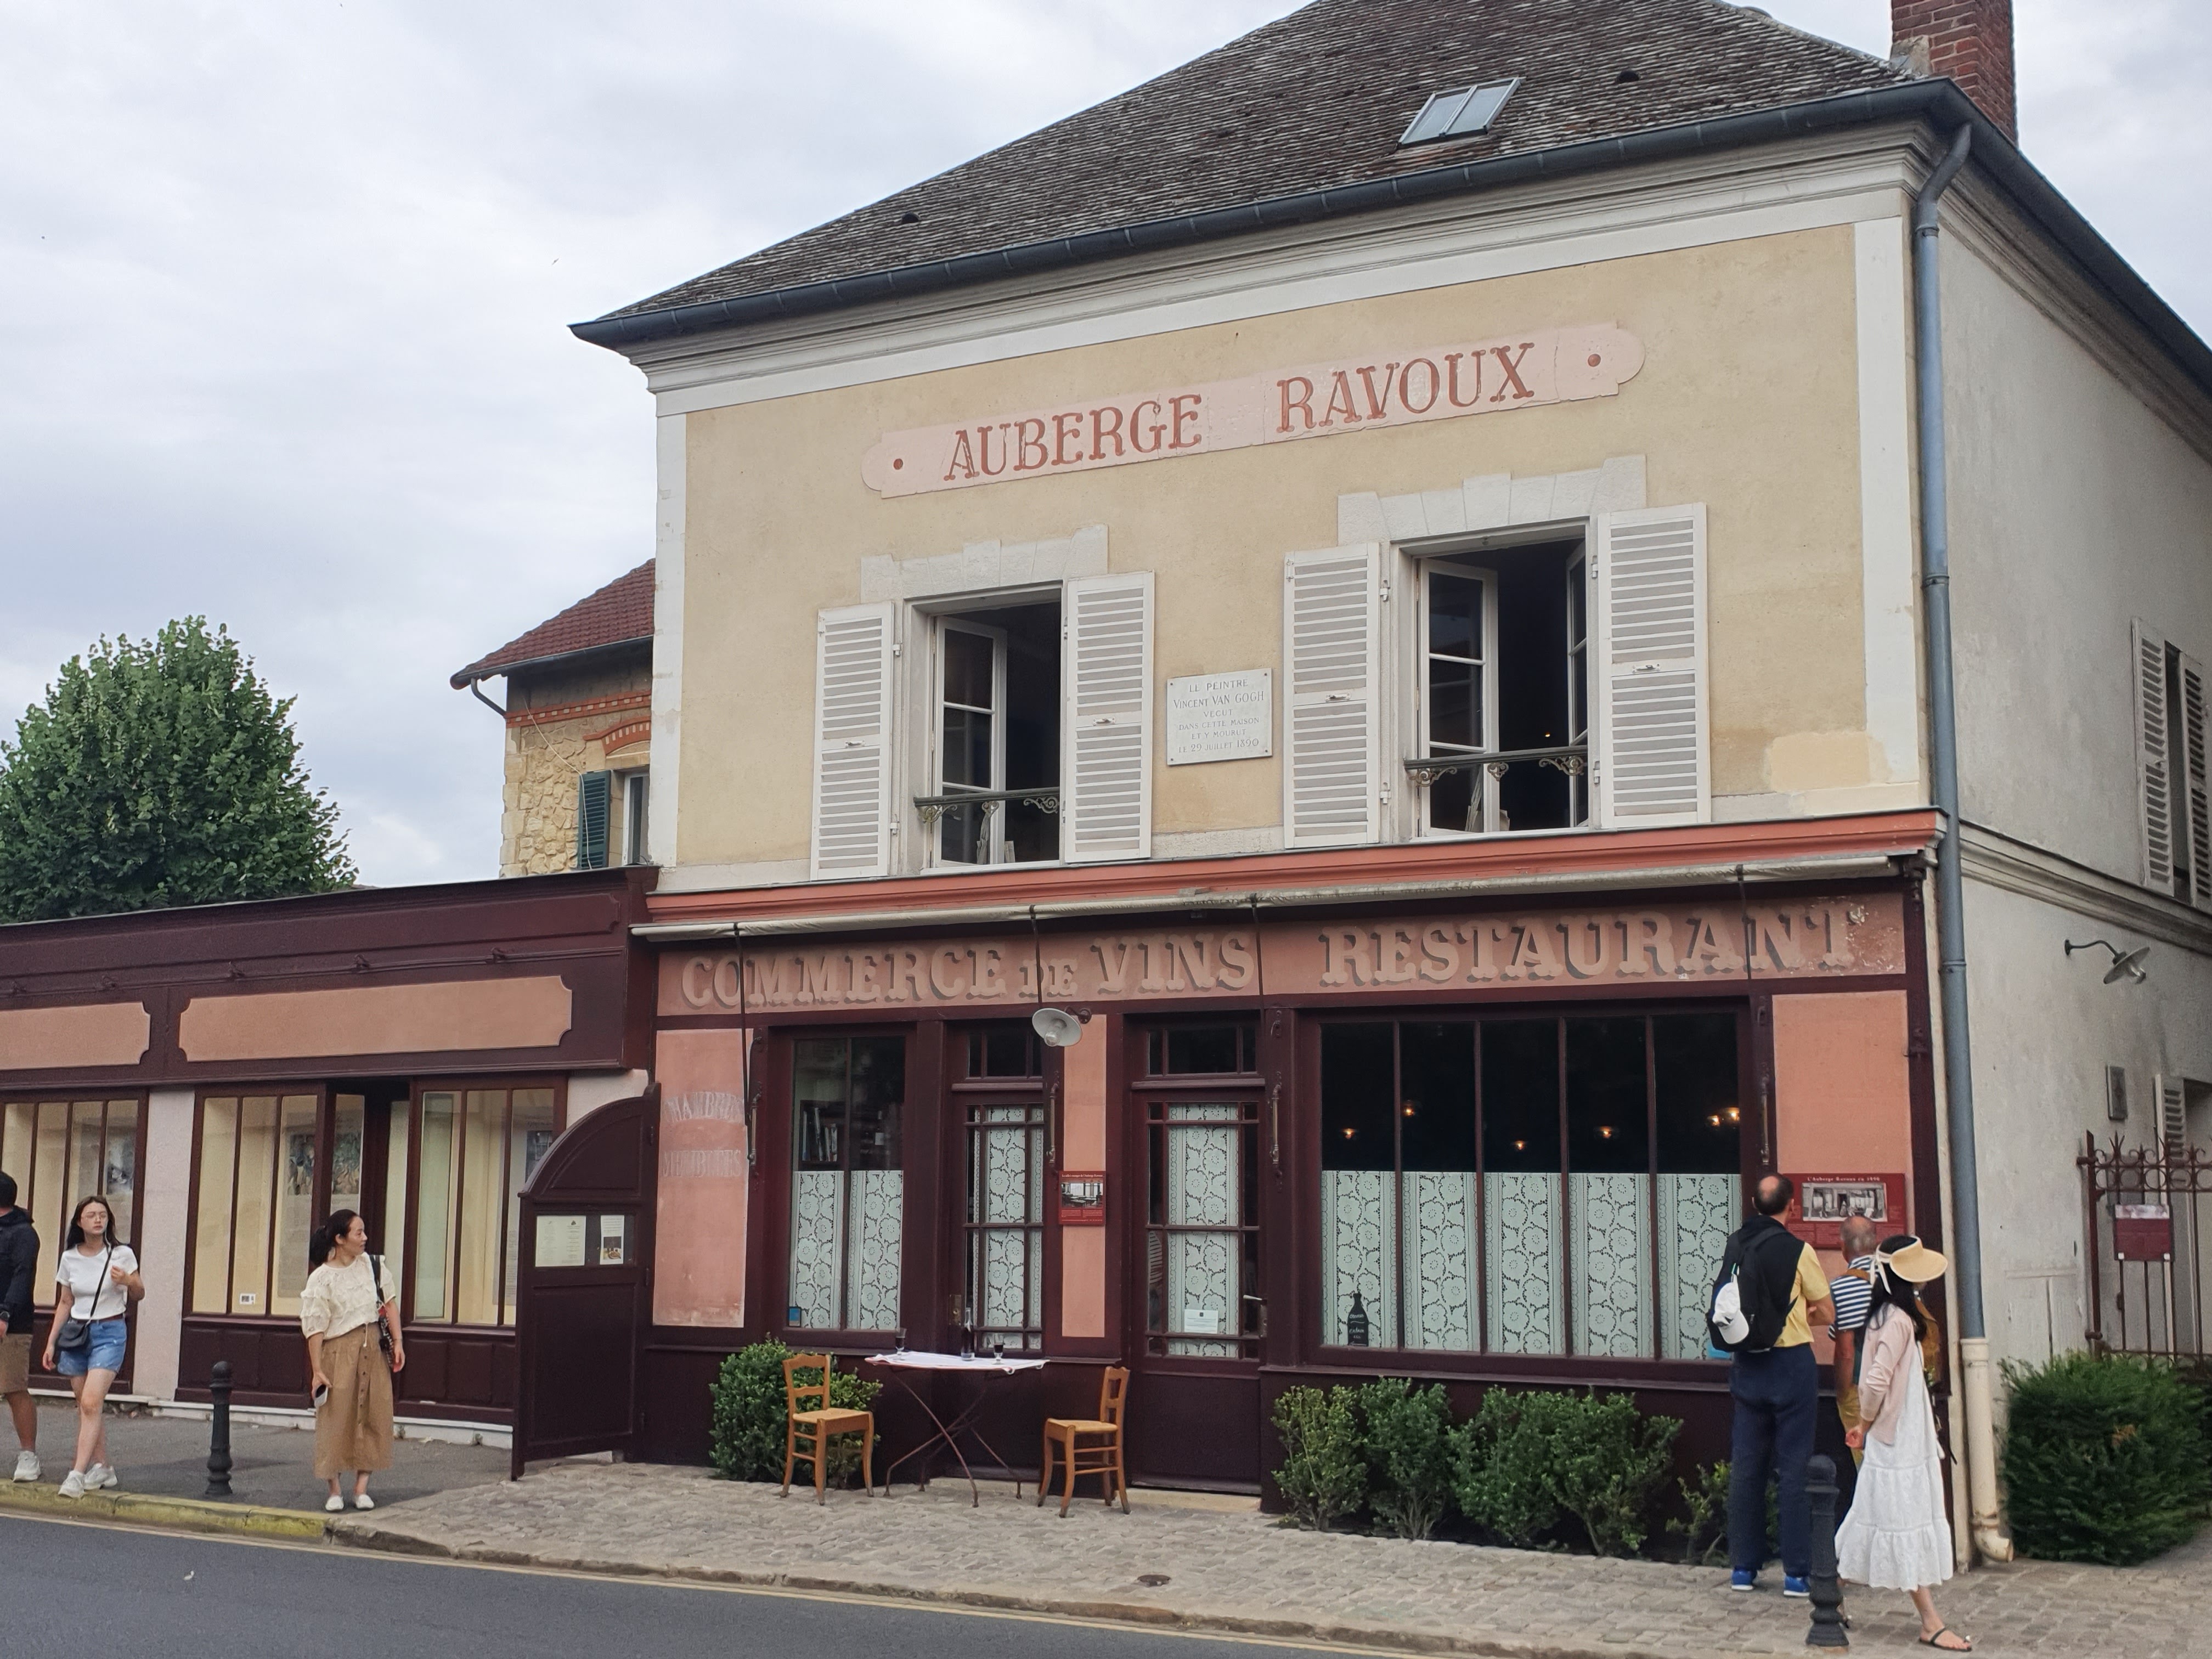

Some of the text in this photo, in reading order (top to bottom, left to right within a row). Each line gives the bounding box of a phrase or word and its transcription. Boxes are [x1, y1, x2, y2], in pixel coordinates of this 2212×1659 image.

[944, 342, 1535, 481] AUBERGE RAVOUX
[1207, 679, 1249, 691] PEINTRE
[1173, 691, 1264, 709] VINCENT VAN GOGH
[1231, 717, 1259, 726] MAISON
[1213, 729, 1246, 737] MOURUT
[1191, 743, 1201, 752] 29
[1205, 742, 1233, 751] JUILLET
[1237, 738, 1259, 747] 1890
[681, 901, 1863, 1009] COMMERCE DE VINS RESTAURANT
